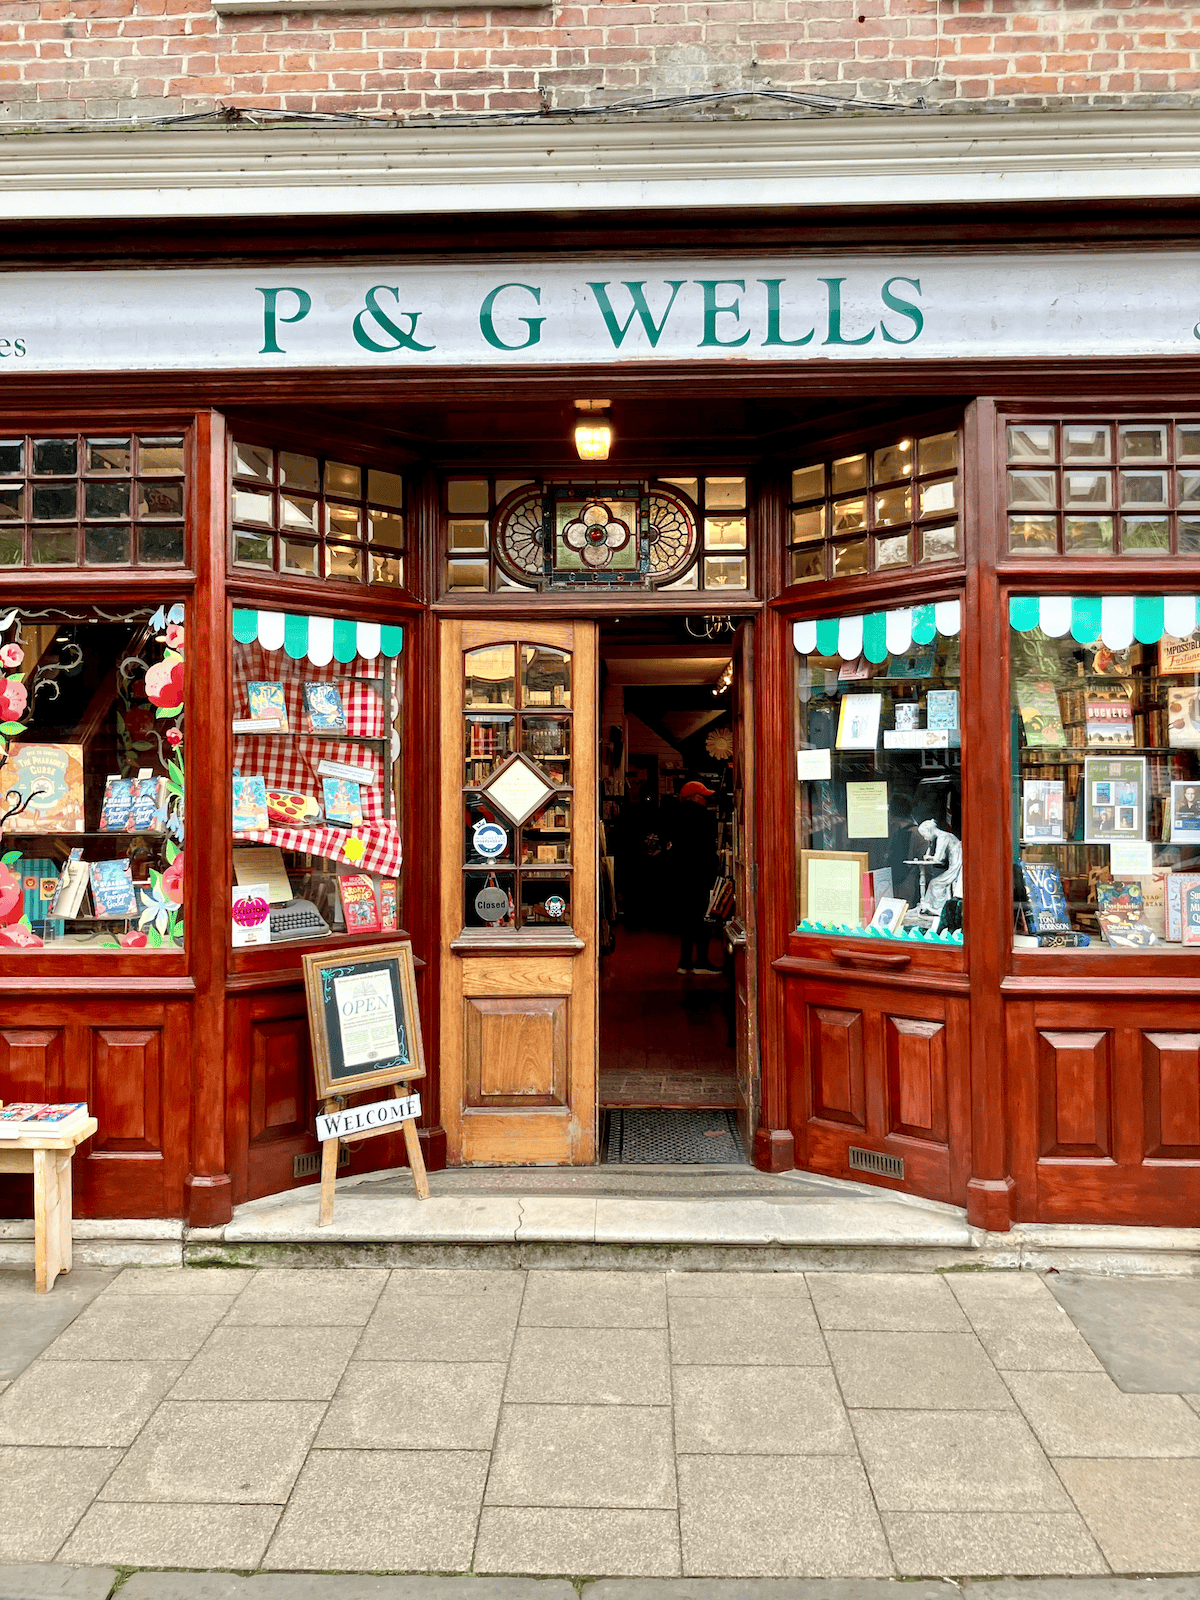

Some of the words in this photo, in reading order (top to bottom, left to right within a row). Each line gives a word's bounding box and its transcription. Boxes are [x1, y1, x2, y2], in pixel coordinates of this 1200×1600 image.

[255, 286, 312, 354] P
[352, 284, 436, 354] &
[479, 282, 547, 352] G
[585, 276, 925, 349] WELLS
[1163, 641, 1200, 656] IMPOSSIBL
[1088, 707, 1128, 718] BUCKEYE
[29, 765, 56, 776] CURSE
[477, 900, 506, 909] Closed
[1103, 901, 1140, 911] Psychedelic
[233, 906, 267, 916] SKELETON
[1038, 916, 1056, 924] TONY
[1038, 922, 1070, 931] ROBINSON
[341, 994, 390, 1017] OPEN
[323, 1099, 417, 1136] WELCOME
